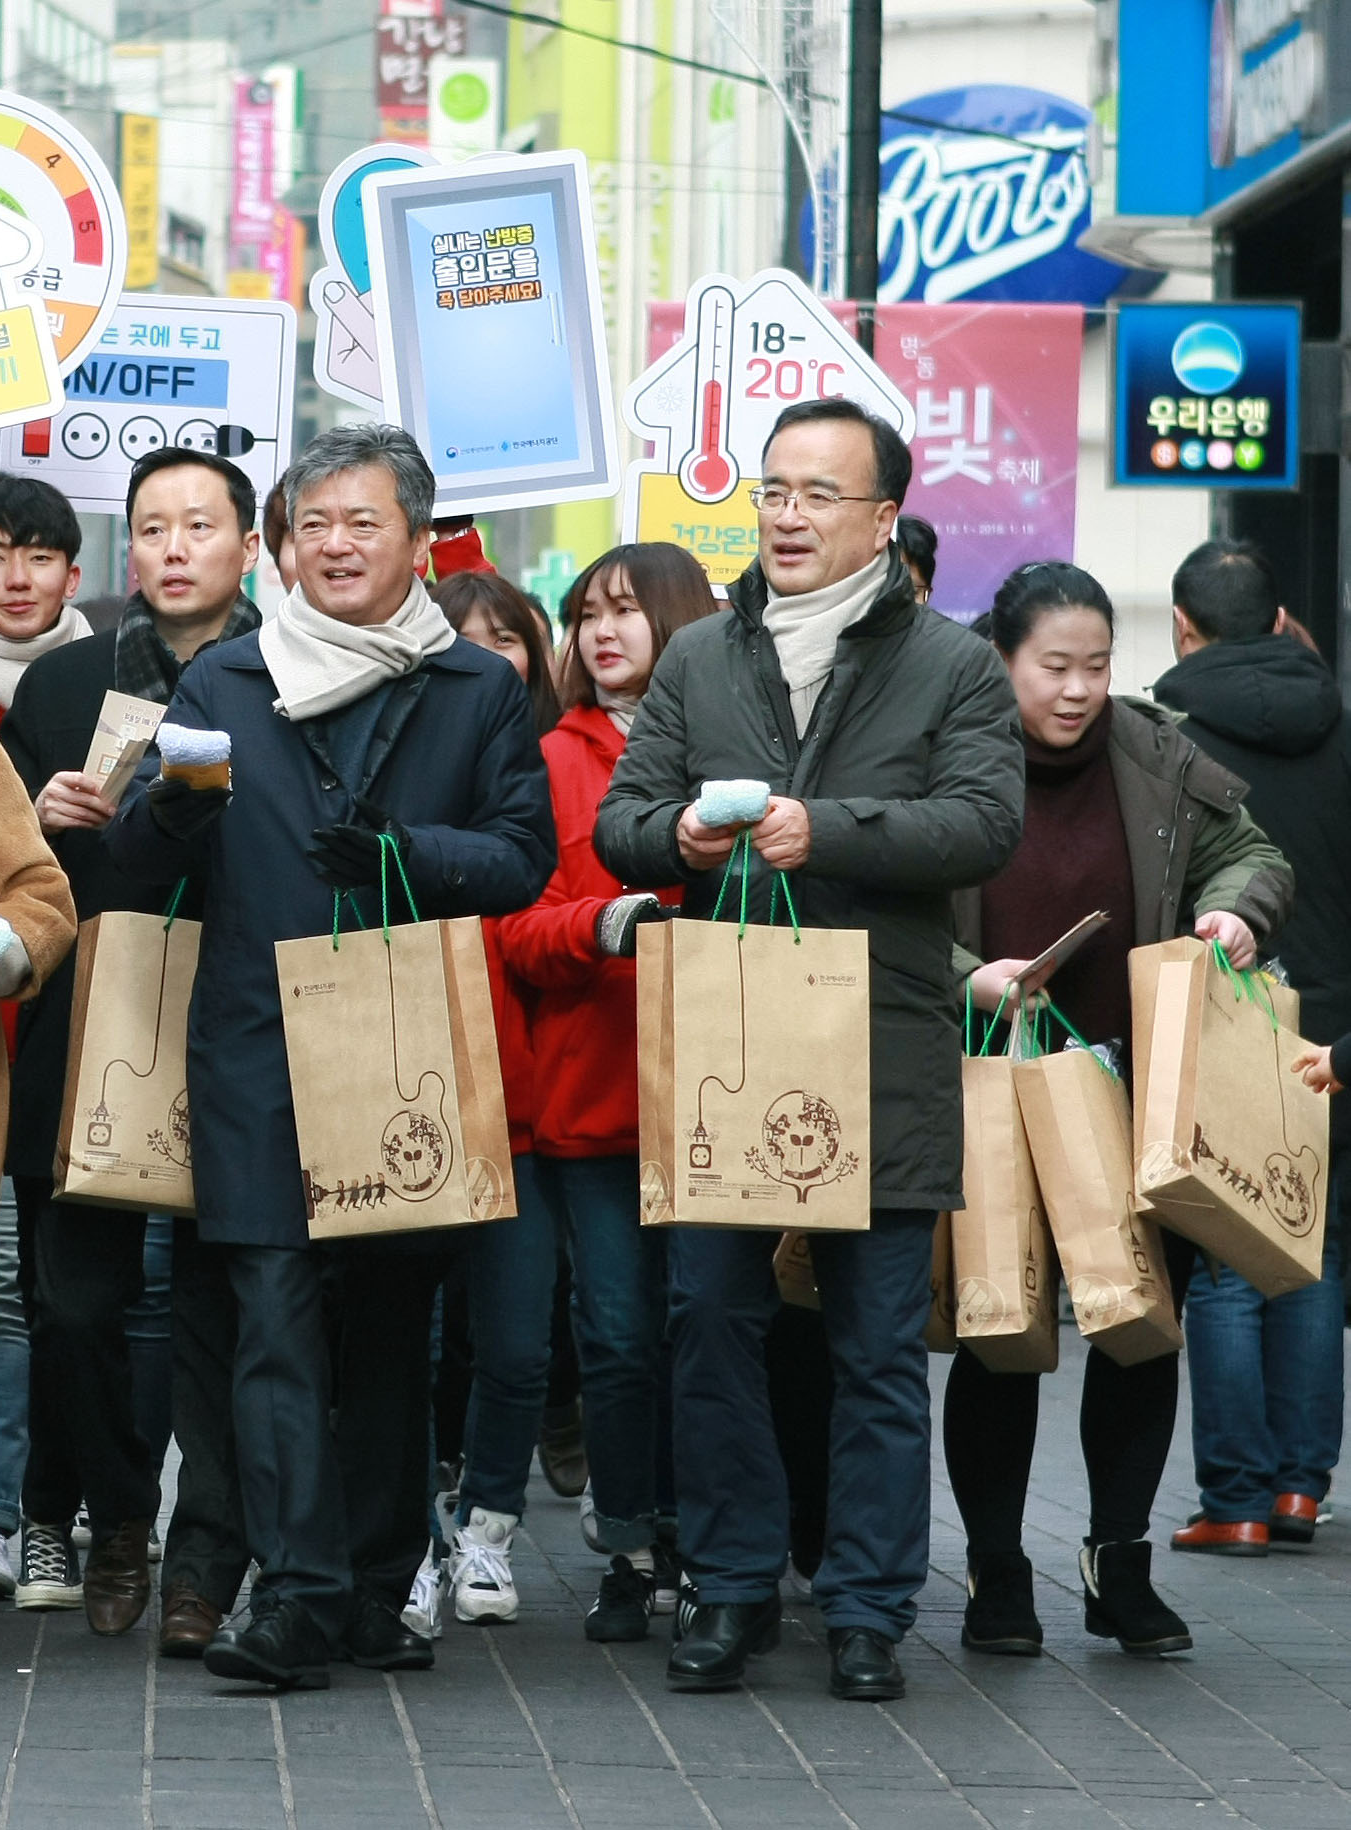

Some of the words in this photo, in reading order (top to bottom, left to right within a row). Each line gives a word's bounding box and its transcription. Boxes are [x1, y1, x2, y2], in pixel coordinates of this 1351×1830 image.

[46, 153, 62, 169] 4
[78, 219, 96, 234] 5
[878, 128, 1086, 305] Boots
[432, 231, 482, 256] 실내는
[484, 223, 534, 249] 난방중
[433, 247, 538, 288] 출입문을
[437, 290, 455, 310] 꼭
[457, 280, 542, 308] 닫아주세요!
[129, 324, 170, 348] 곳에
[179, 327, 221, 350] 두고
[749, 321, 806, 354] 18-
[1147, 396, 1270, 437] 우리은행
[915, 386, 992, 486] 빛
[997, 459, 1040, 486] 축제
